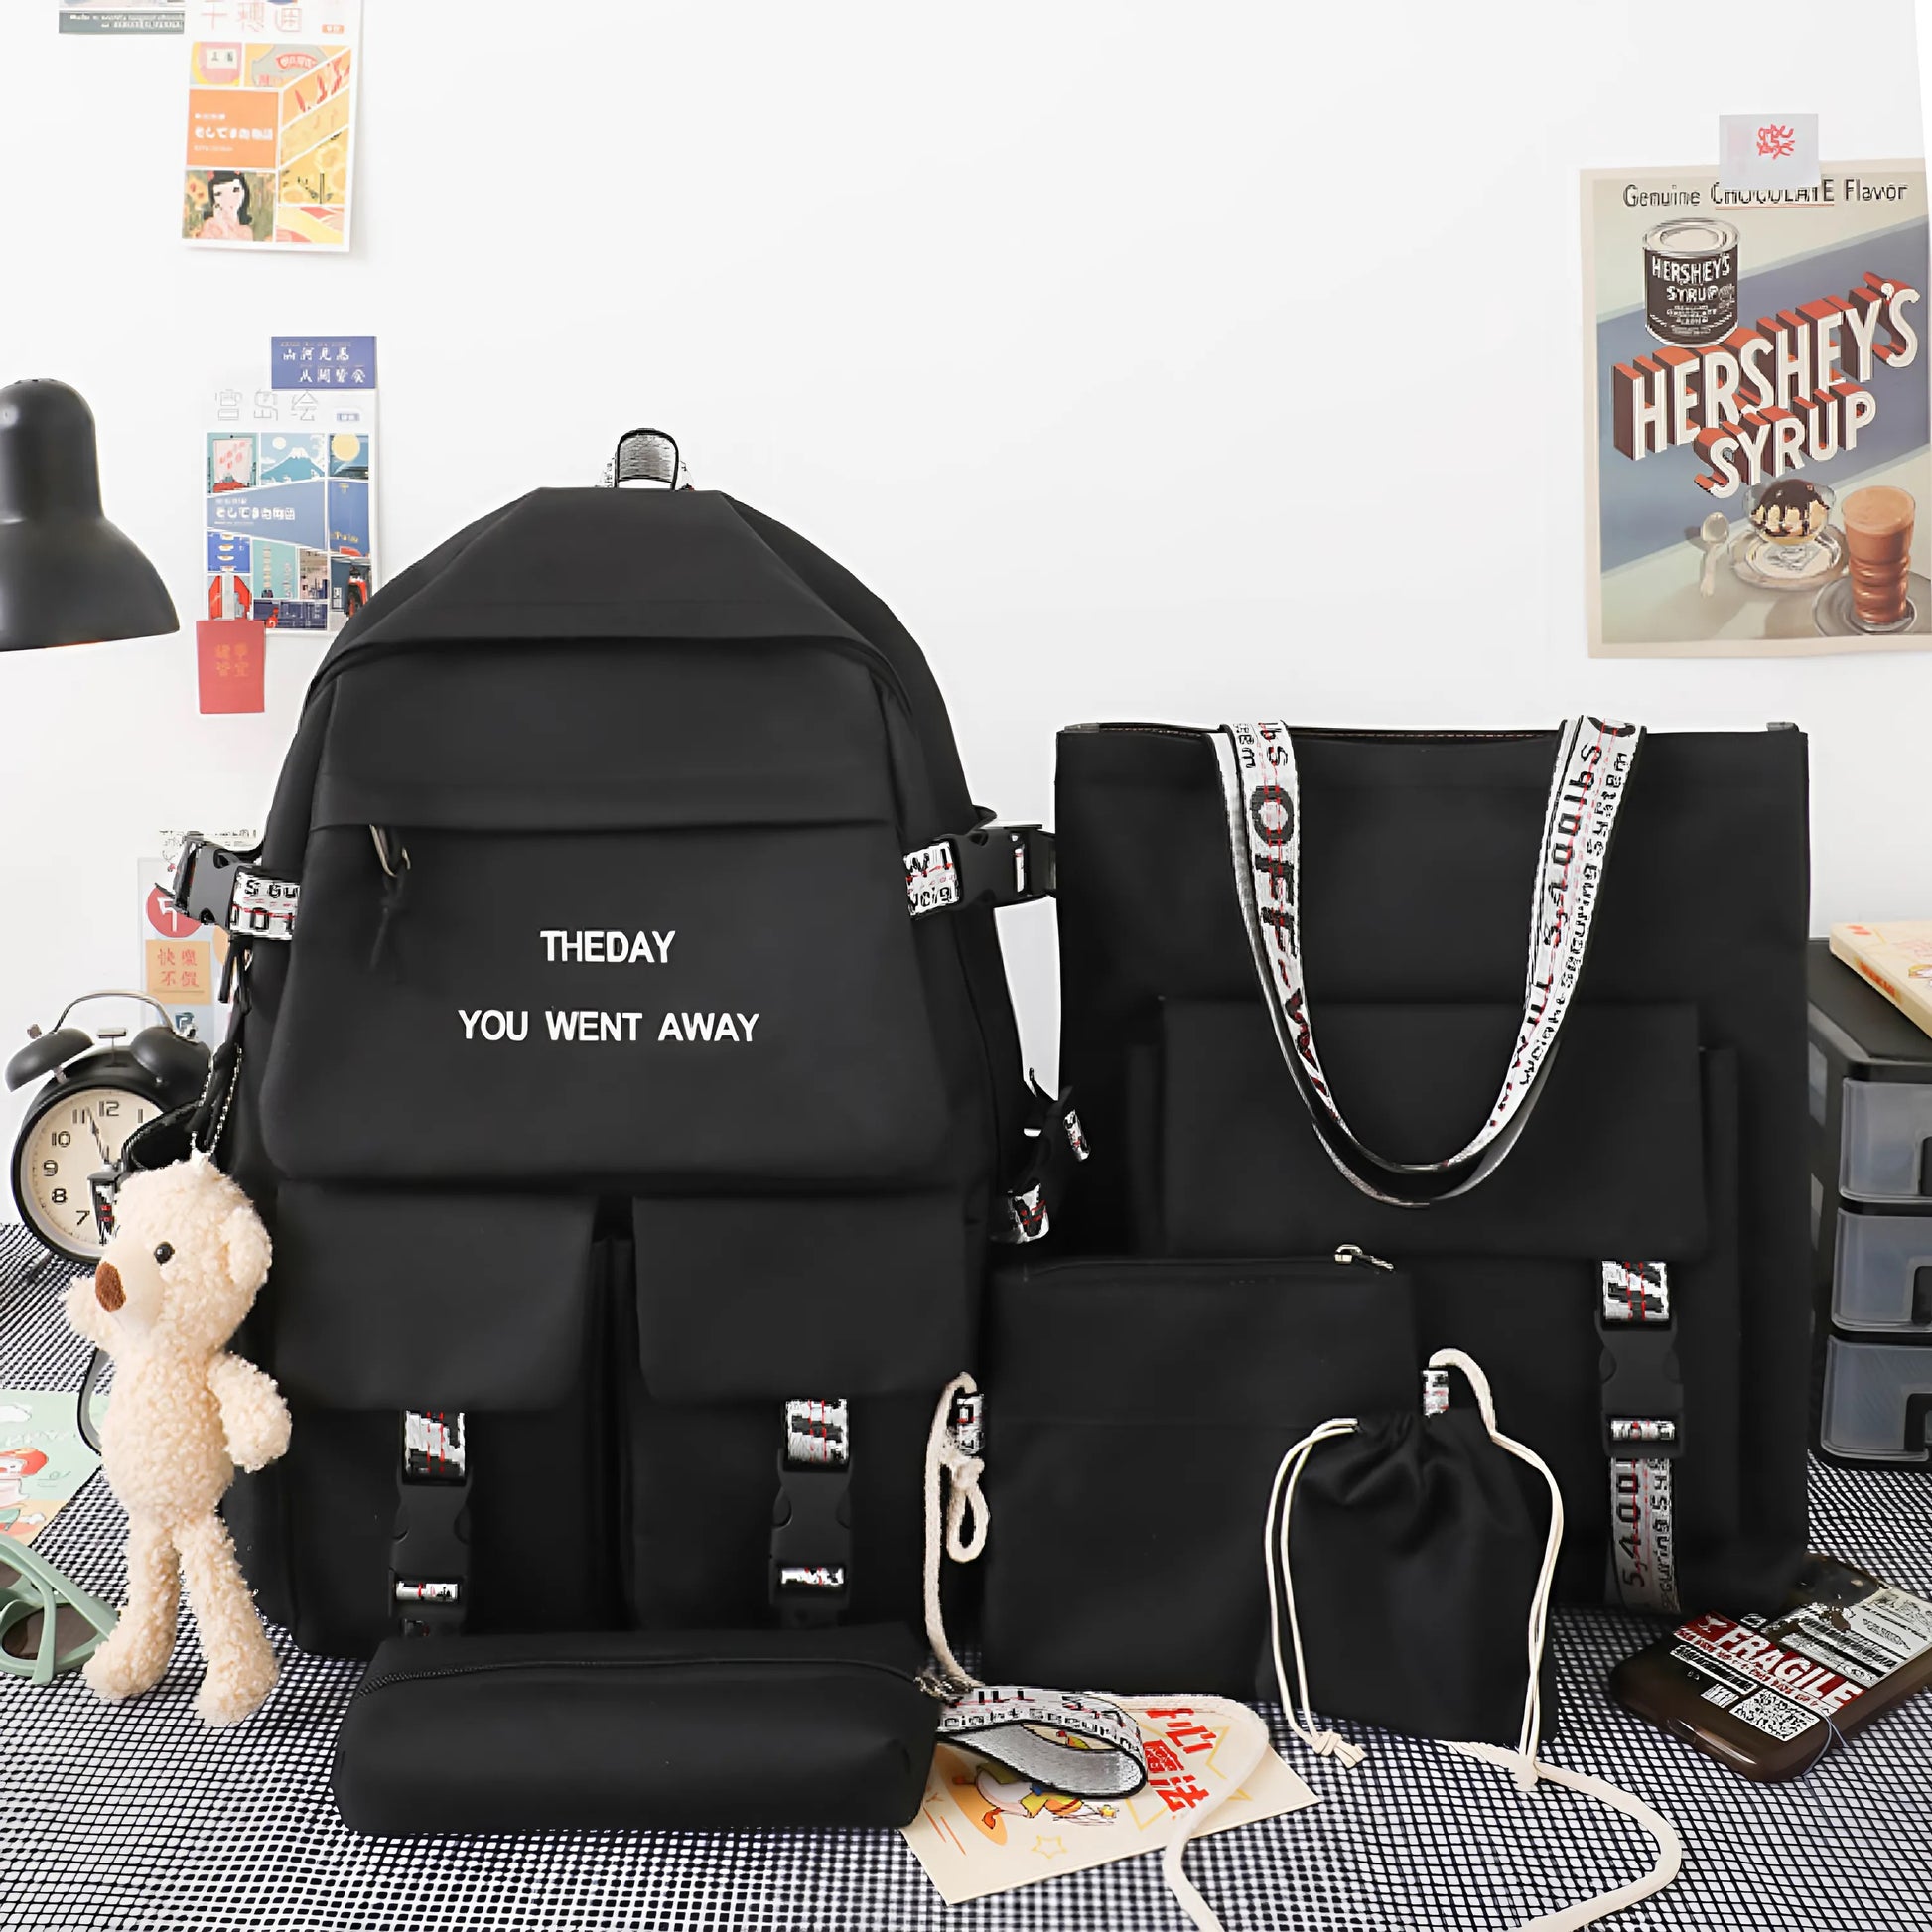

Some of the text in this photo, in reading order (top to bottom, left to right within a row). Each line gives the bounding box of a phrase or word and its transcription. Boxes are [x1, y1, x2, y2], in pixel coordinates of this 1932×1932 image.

[1623, 184, 1701, 207] Genuine
[1844, 178, 1908, 201] Flavor
[1652, 252, 1730, 285] HERSHEY'S
[1666, 285, 1718, 303] SYRUP
[1618, 274, 1920, 461] HERSHEY'S
[1698, 385, 1876, 499] SYRUP
[540, 930, 676, 963] THEDAY
[458, 1009, 759, 1042] YOU WENT AWAY
[99, 1100, 120, 1117] 12
[51, 1130, 71, 1148] 10
[43, 1160, 59, 1177] 9
[51, 1187, 68, 1204] 8
[75, 1210, 91, 1226] 7
[1711, 1625, 1866, 1709] FRAGILE
